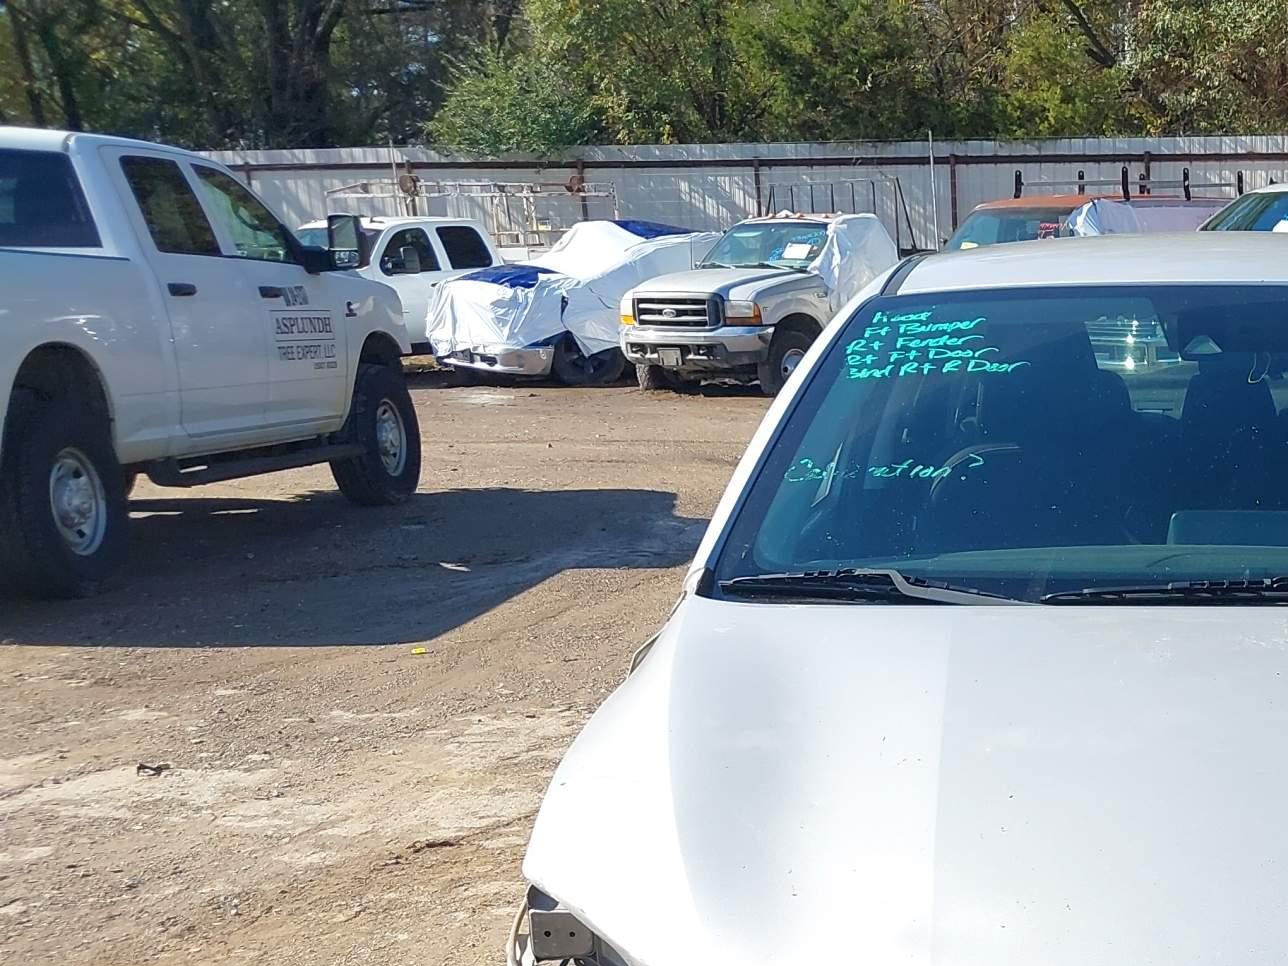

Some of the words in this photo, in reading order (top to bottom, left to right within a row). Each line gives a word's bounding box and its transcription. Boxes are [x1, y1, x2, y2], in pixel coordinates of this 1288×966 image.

[275, 316, 333, 335] ASPLUNDH
[899, 317, 986, 334] Bumper
[896, 335, 984, 348] Fender
[928, 347, 999, 360] Door
[967, 359, 1031, 372] Door
